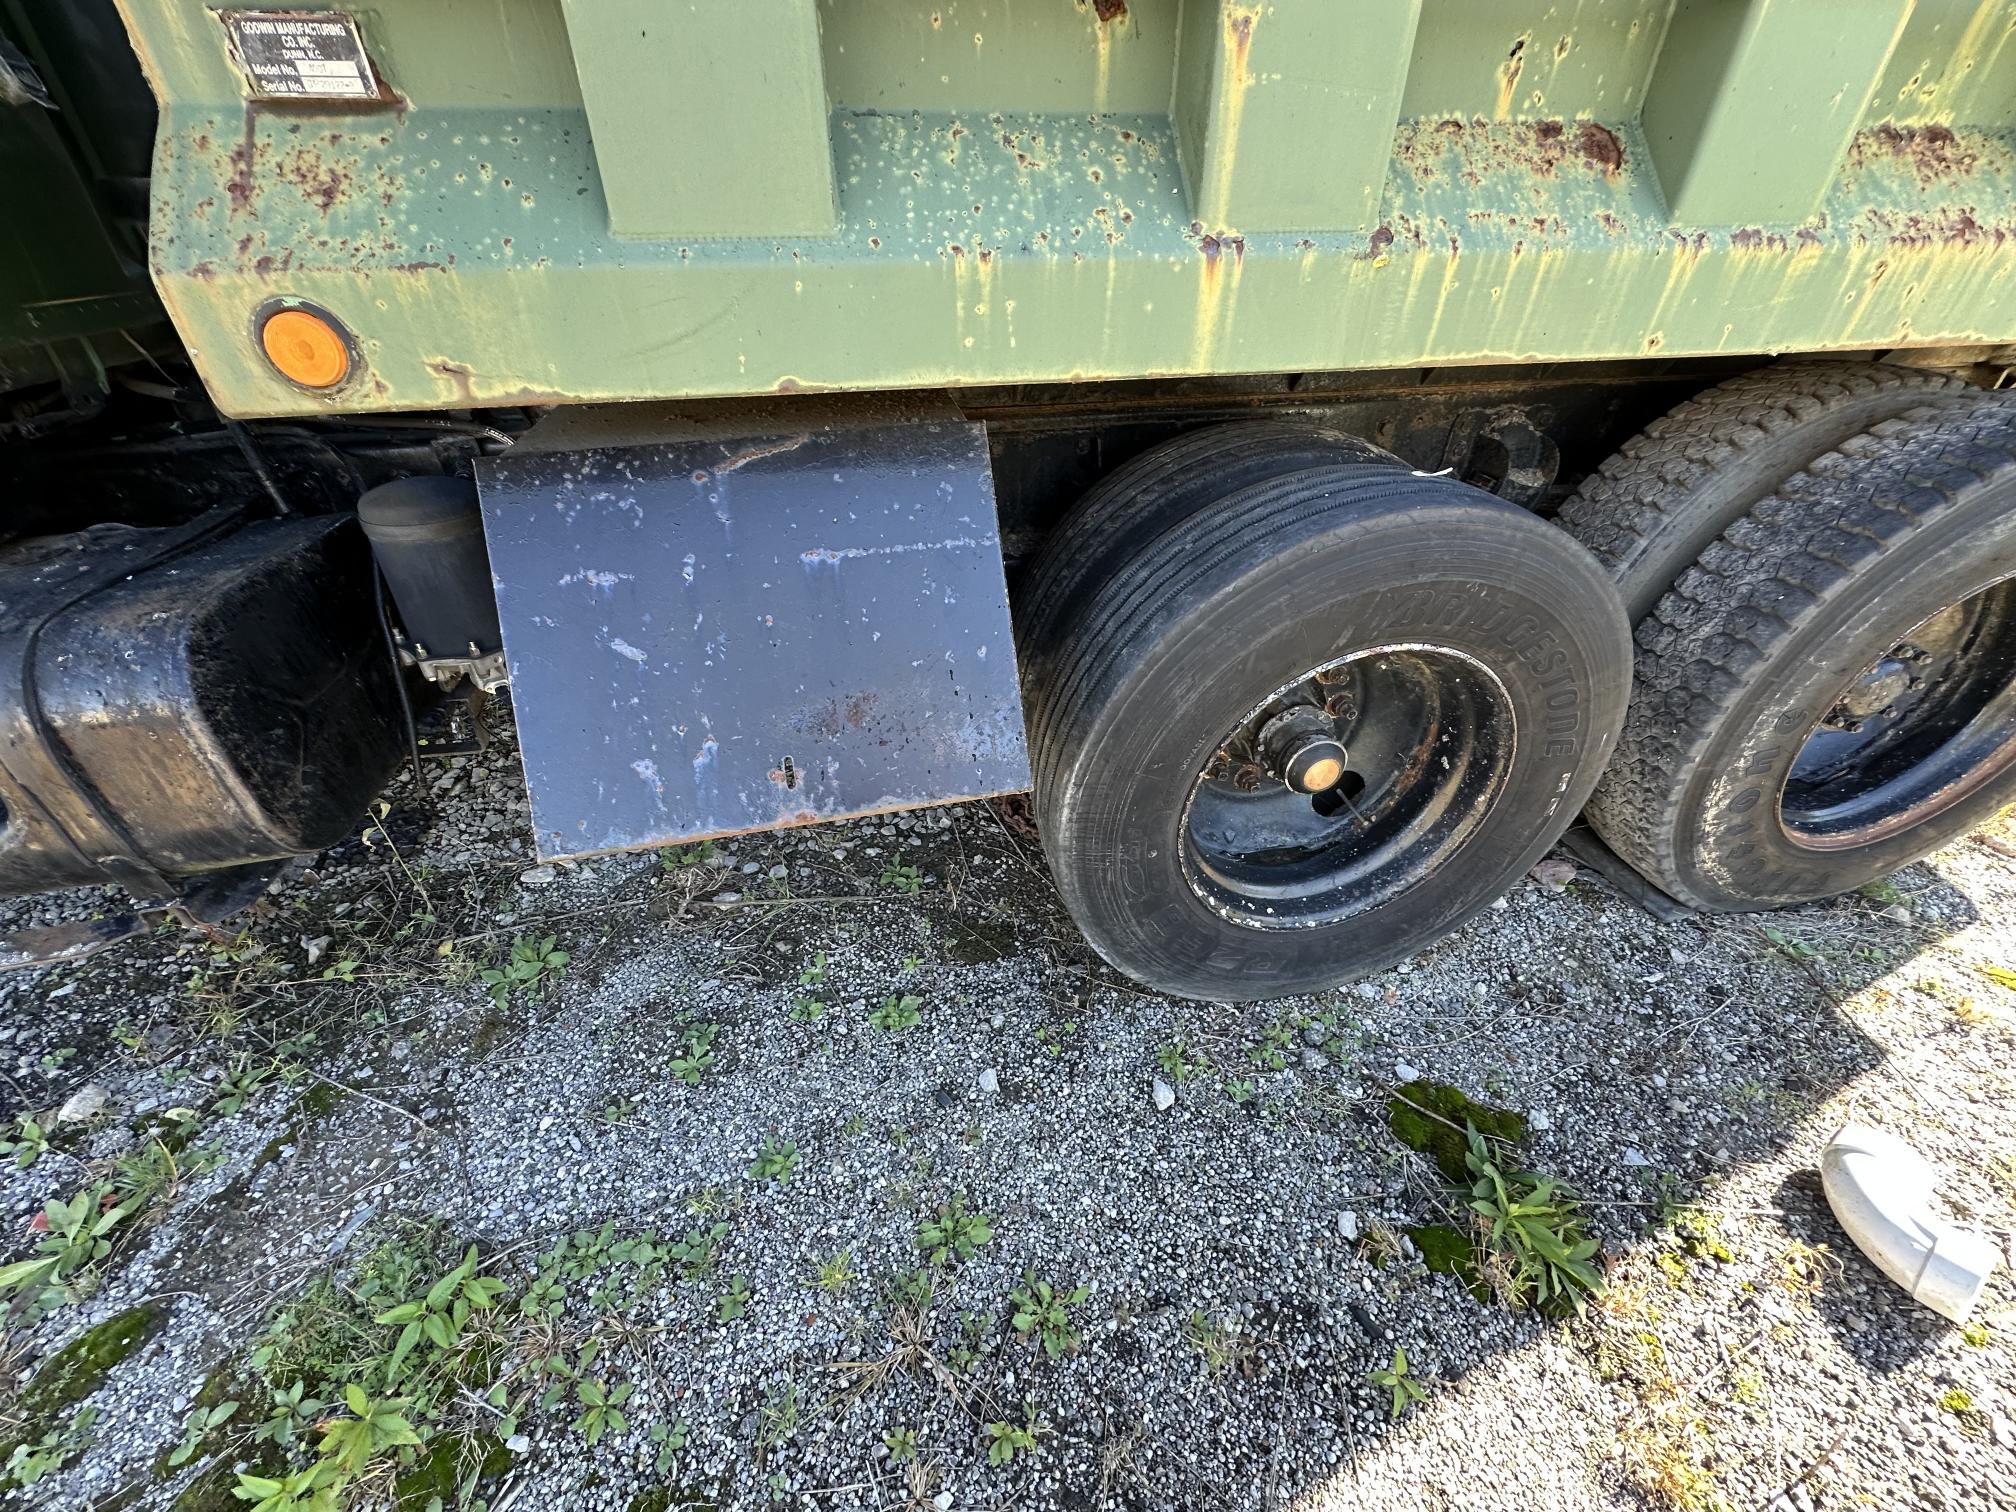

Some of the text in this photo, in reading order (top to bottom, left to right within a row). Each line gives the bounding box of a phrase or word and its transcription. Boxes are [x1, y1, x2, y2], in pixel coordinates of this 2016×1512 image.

[240, 21, 347, 36] GODWIN MANUFACTURING
[281, 36, 316, 48] CO. INC.
[252, 64, 283, 75] Model
[283, 64, 299, 76] No.
[261, 81, 288, 92] Serial
[288, 81, 305, 92] No.
[1382, 589, 1581, 759] BRIDGESTONE
